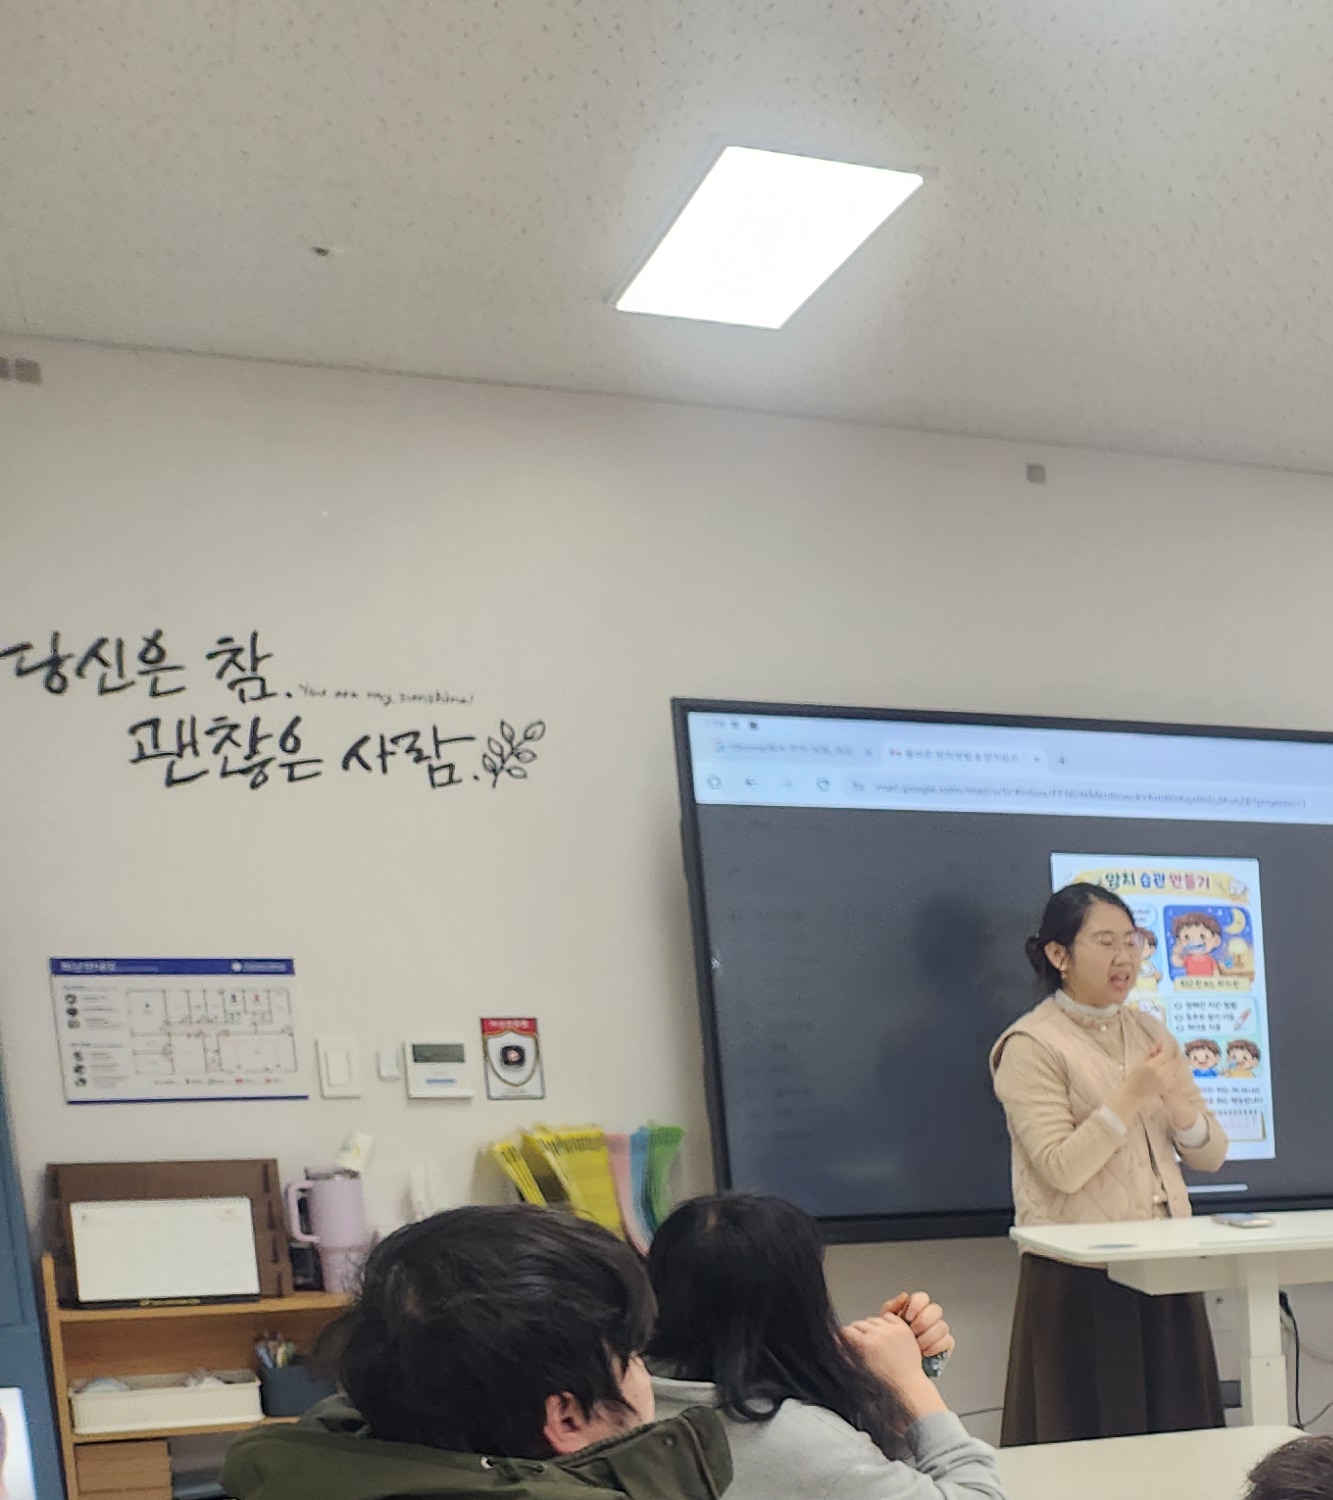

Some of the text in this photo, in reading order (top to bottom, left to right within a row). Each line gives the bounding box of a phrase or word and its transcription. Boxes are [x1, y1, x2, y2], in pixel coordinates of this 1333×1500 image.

[0, 629, 186, 696] 당신은
[128, 715, 323, 790] 괜찮은
[1140, 872, 1165, 888] 습관
[1169, 873, 1210, 891] 만들기
